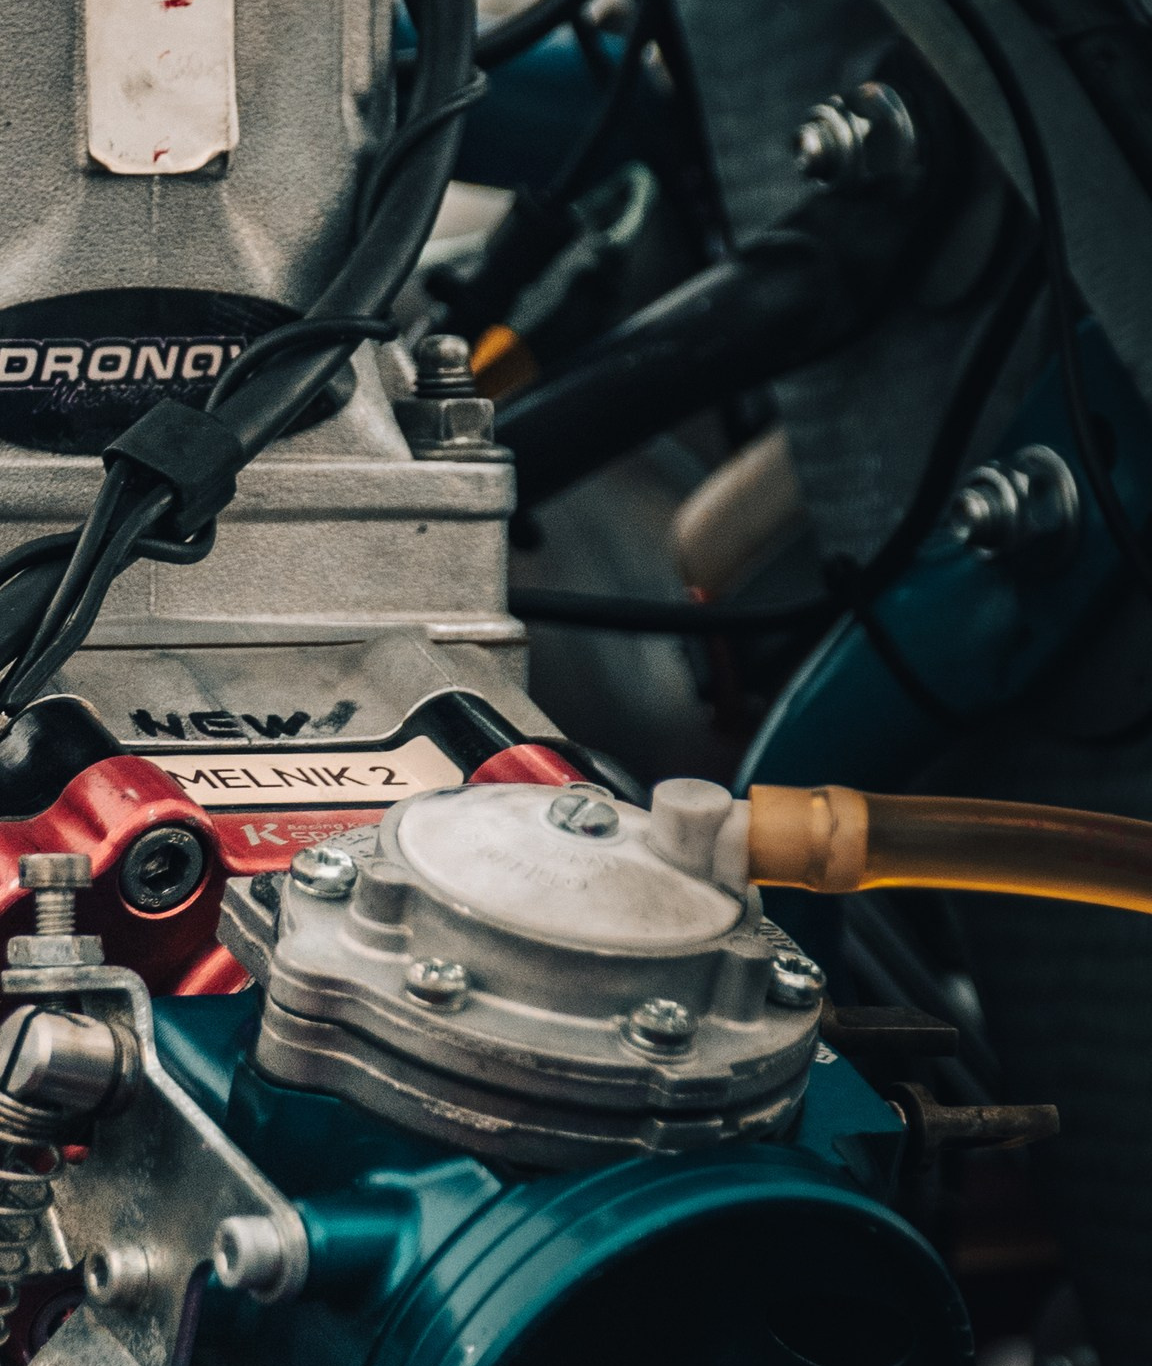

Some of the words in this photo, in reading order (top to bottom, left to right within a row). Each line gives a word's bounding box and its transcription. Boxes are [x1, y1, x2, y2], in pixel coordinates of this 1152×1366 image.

[129, 708, 311, 740] NEW
[164, 766, 371, 791] MELNIK
[368, 766, 409, 786] 2
